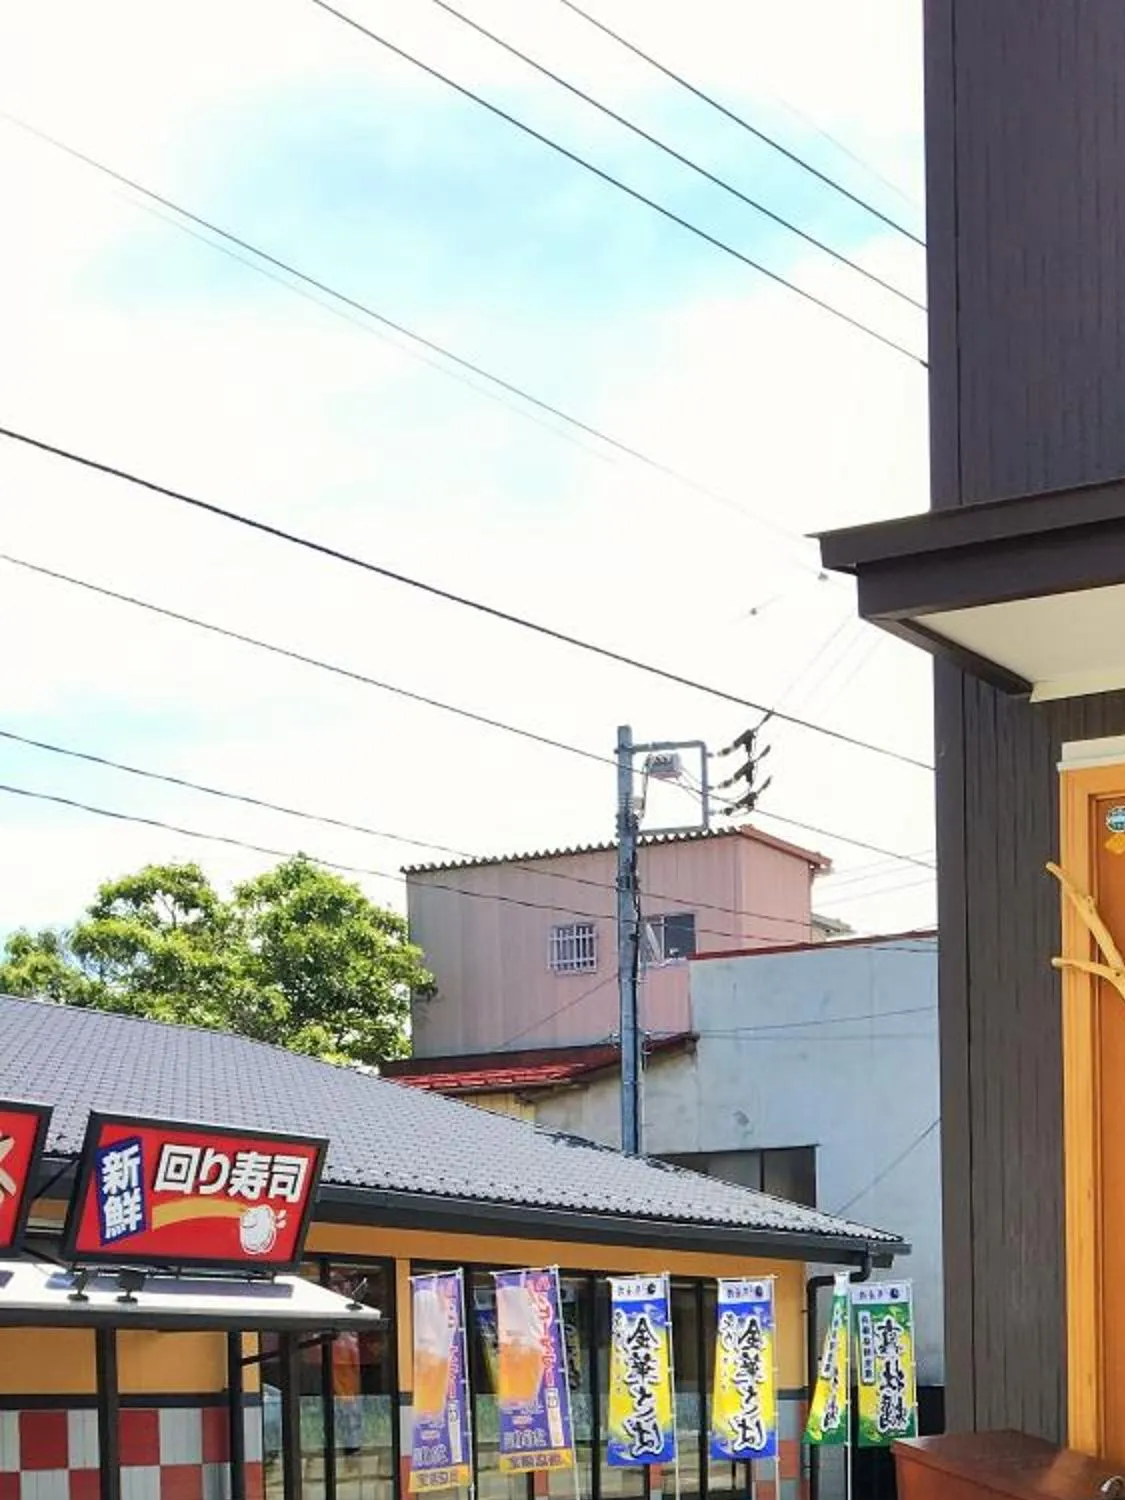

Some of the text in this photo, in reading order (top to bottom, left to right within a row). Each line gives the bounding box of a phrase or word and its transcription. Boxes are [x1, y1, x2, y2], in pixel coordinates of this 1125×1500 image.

[101, 1144, 142, 1239] 新鮮
[153, 1143, 310, 1203] 回り寿司
